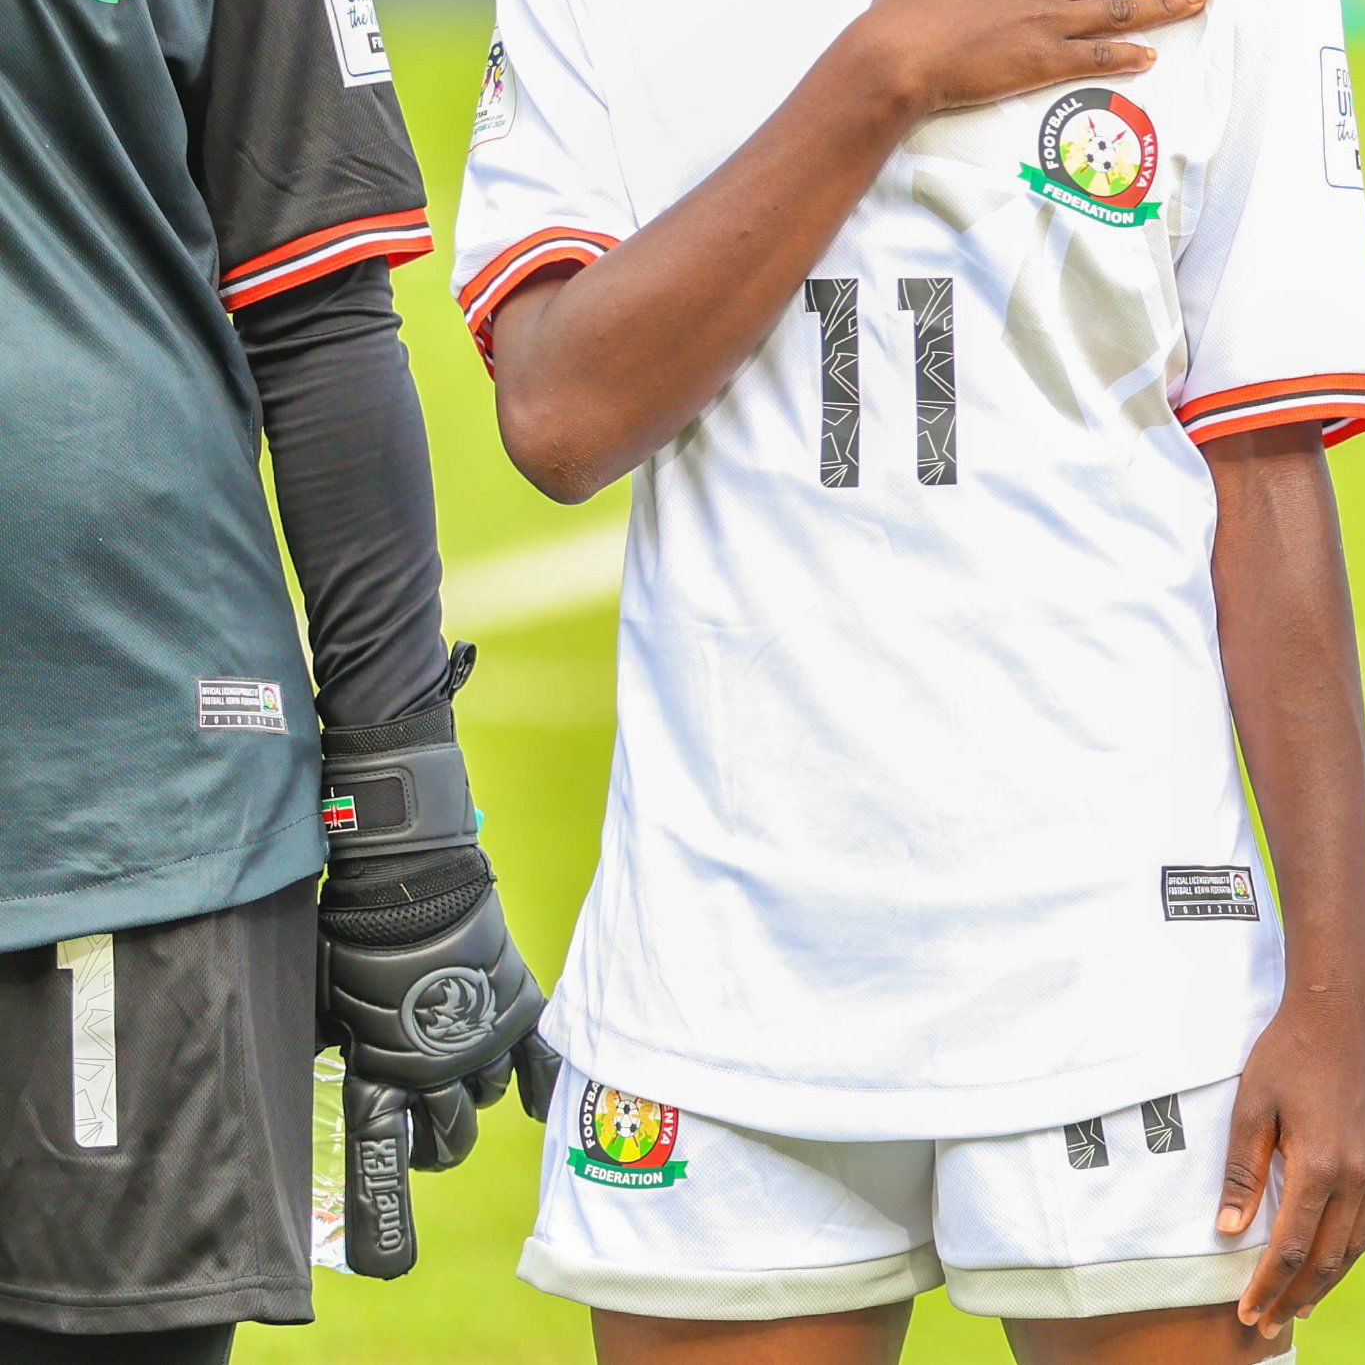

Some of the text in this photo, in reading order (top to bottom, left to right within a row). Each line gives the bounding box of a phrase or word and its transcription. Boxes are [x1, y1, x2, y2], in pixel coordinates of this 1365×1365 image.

[1043, 97, 1083, 170] FOOTBALL
[1135, 133, 1154, 189] KENYA
[1042, 183, 1134, 224] FEDERATION
[805, 278, 957, 487] 11
[56, 933, 118, 1148] 1
[584, 1163, 663, 1185] FEDERATION
